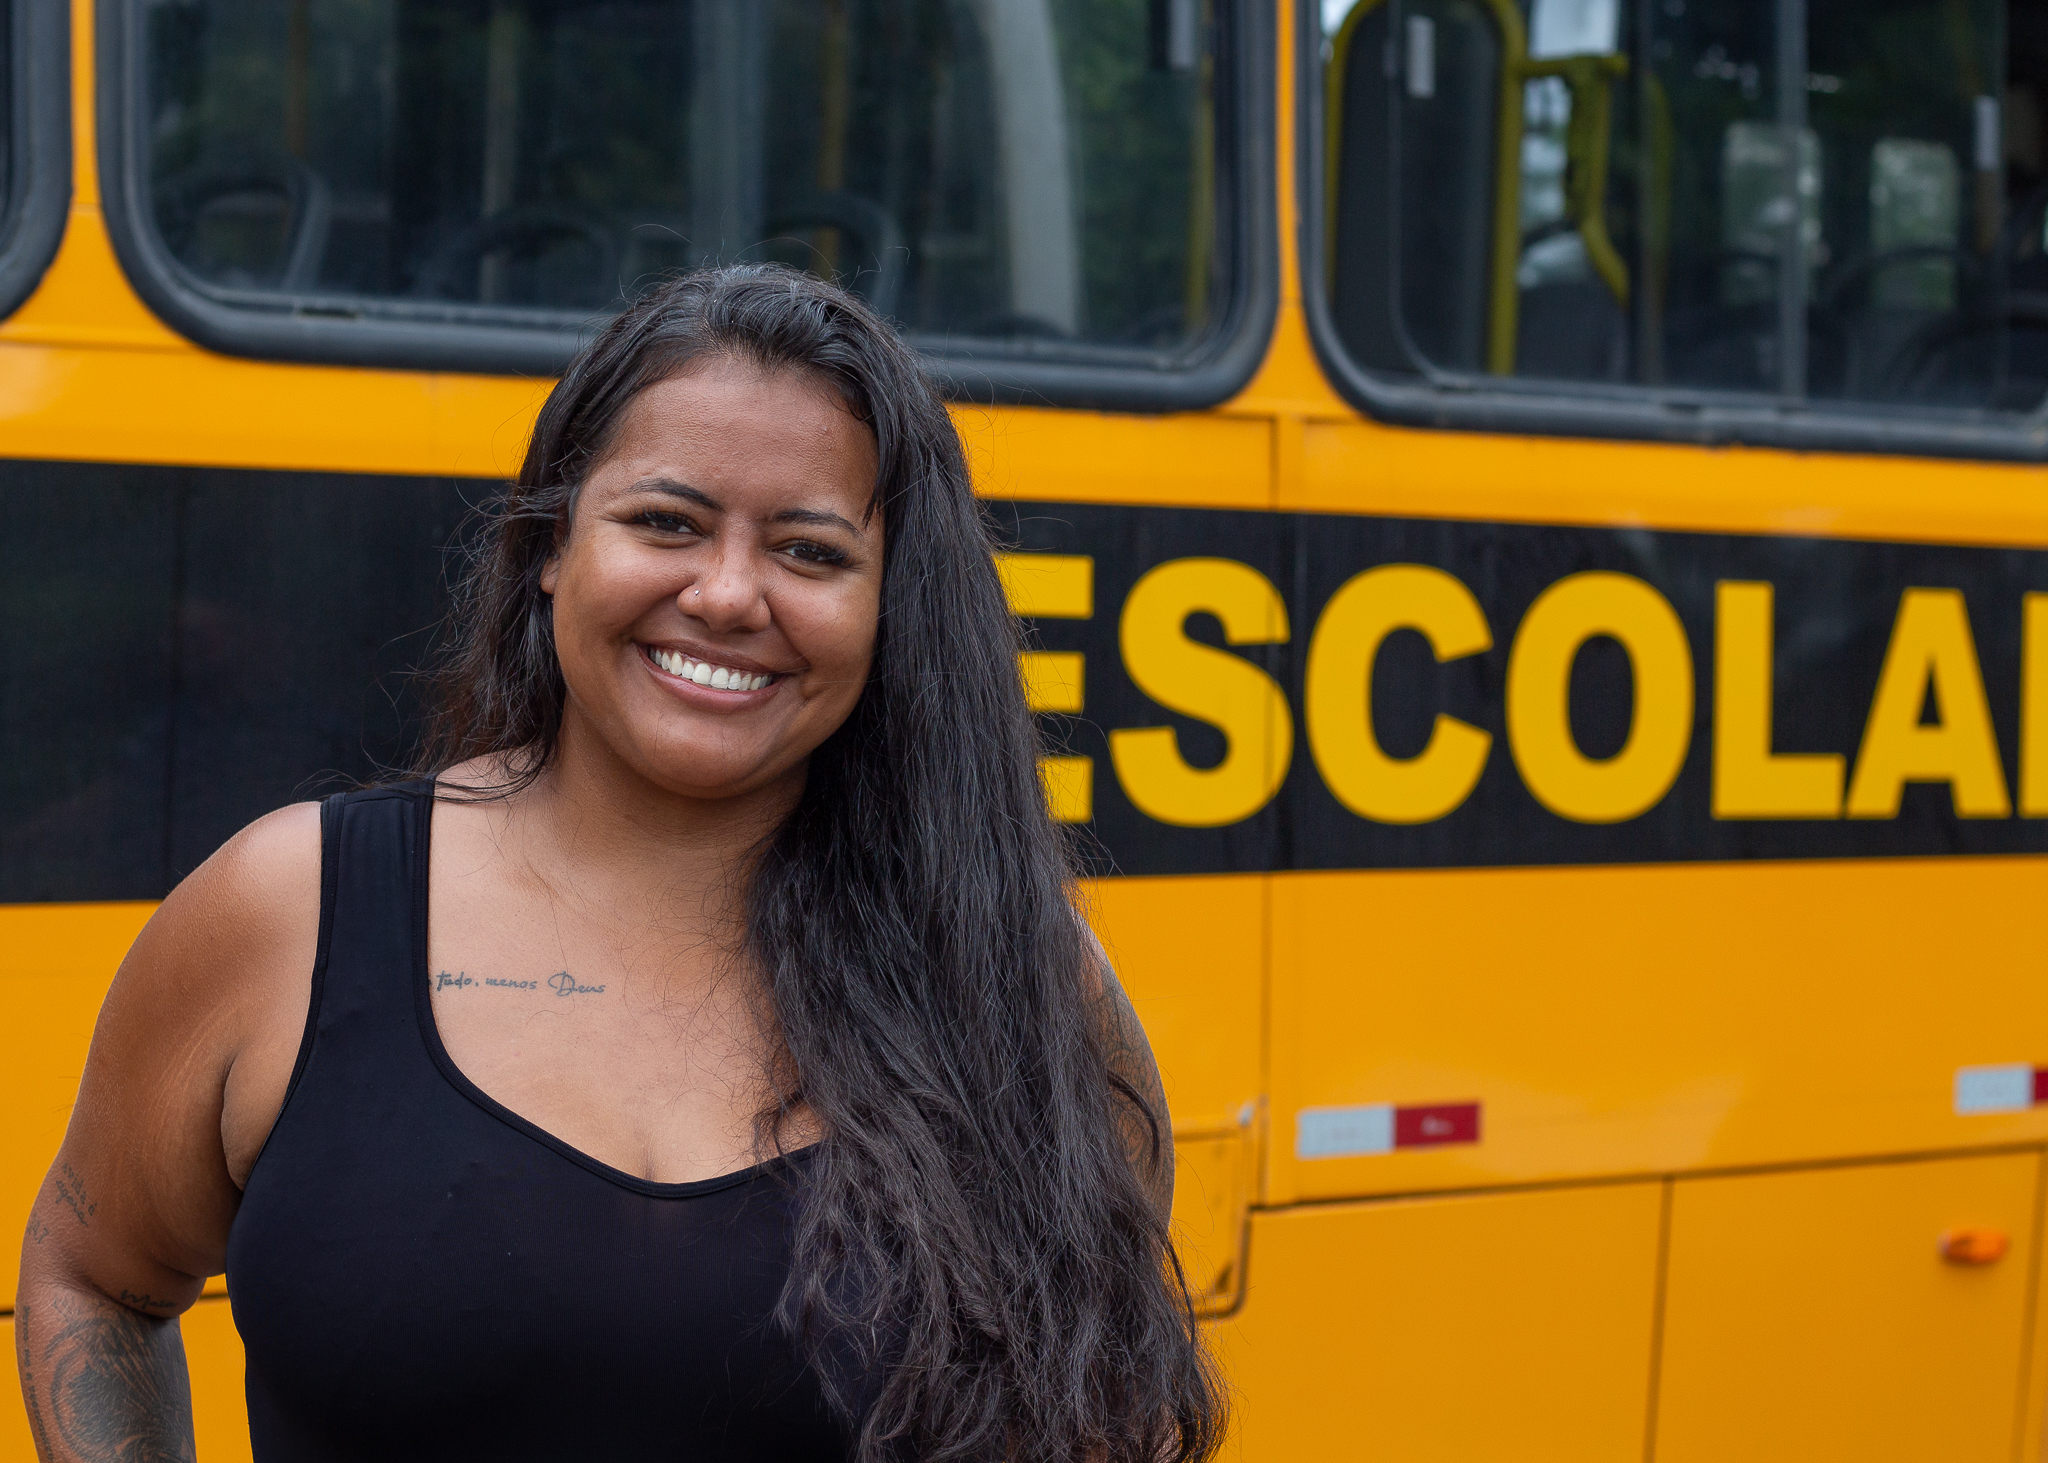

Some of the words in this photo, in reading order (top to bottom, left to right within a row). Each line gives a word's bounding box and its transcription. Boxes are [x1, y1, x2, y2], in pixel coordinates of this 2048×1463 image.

[991, 552, 2048, 828] ESCOLA
[485, 977, 538, 990] menos
[547, 970, 606, 997] Deus
